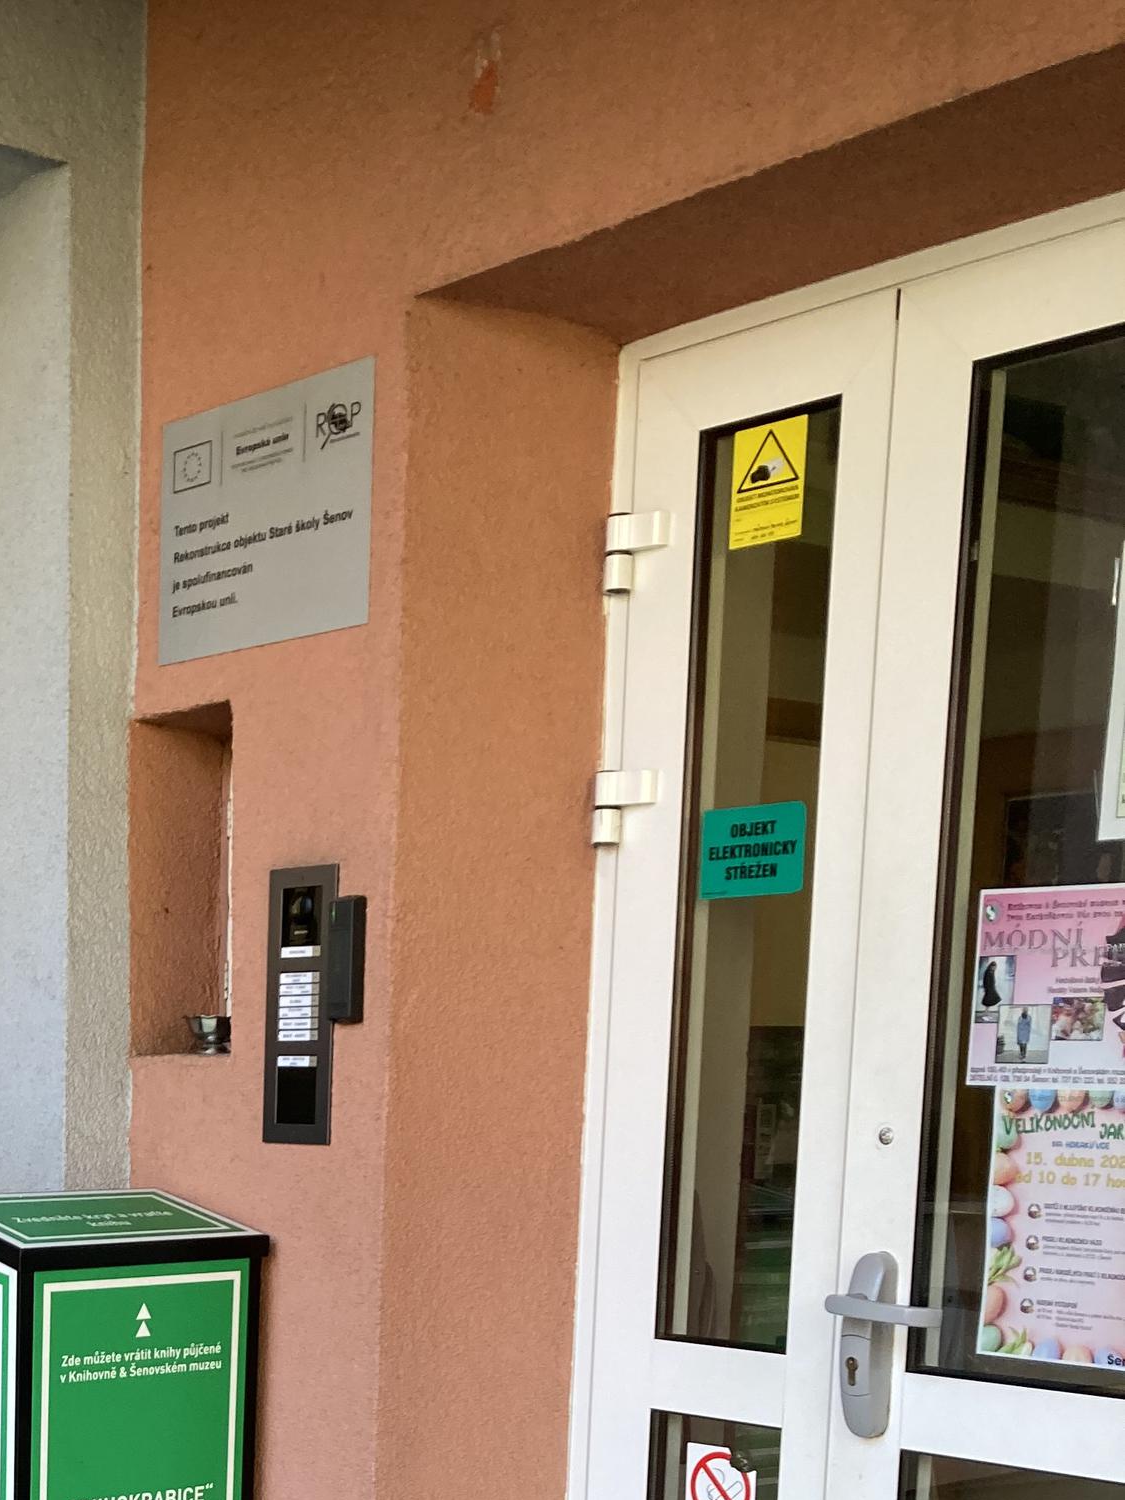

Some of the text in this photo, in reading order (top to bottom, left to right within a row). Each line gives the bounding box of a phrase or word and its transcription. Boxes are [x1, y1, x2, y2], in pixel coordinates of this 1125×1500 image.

[174, 512, 229, 537] Tento projekt
[174, 509, 353, 563] Rekonstrukce objektu Staré školy Šenov
[172, 562, 253, 594] je spolufinancován
[172, 600, 217, 618] Evropskou
[730, 820, 777, 838] OBJEKT
[709, 840, 797, 861] ELEKTRONICKY
[725, 861, 778, 880] STŘEŽEN
[983, 921, 1083, 950] MÓDNÍ
[1026, 1152, 1047, 1166] 15.
[1054, 1153, 1095, 1167] dubna
[1038, 1170, 1056, 1184] 10
[1061, 1171, 1077, 1185] do
[1083, 1172, 1101, 1186] 17
[61, 1341, 222, 1368] Zde můžete vrátit knihy půjčené
[59, 1360, 222, 1383] v Knihovně & Šenovském muzeu
